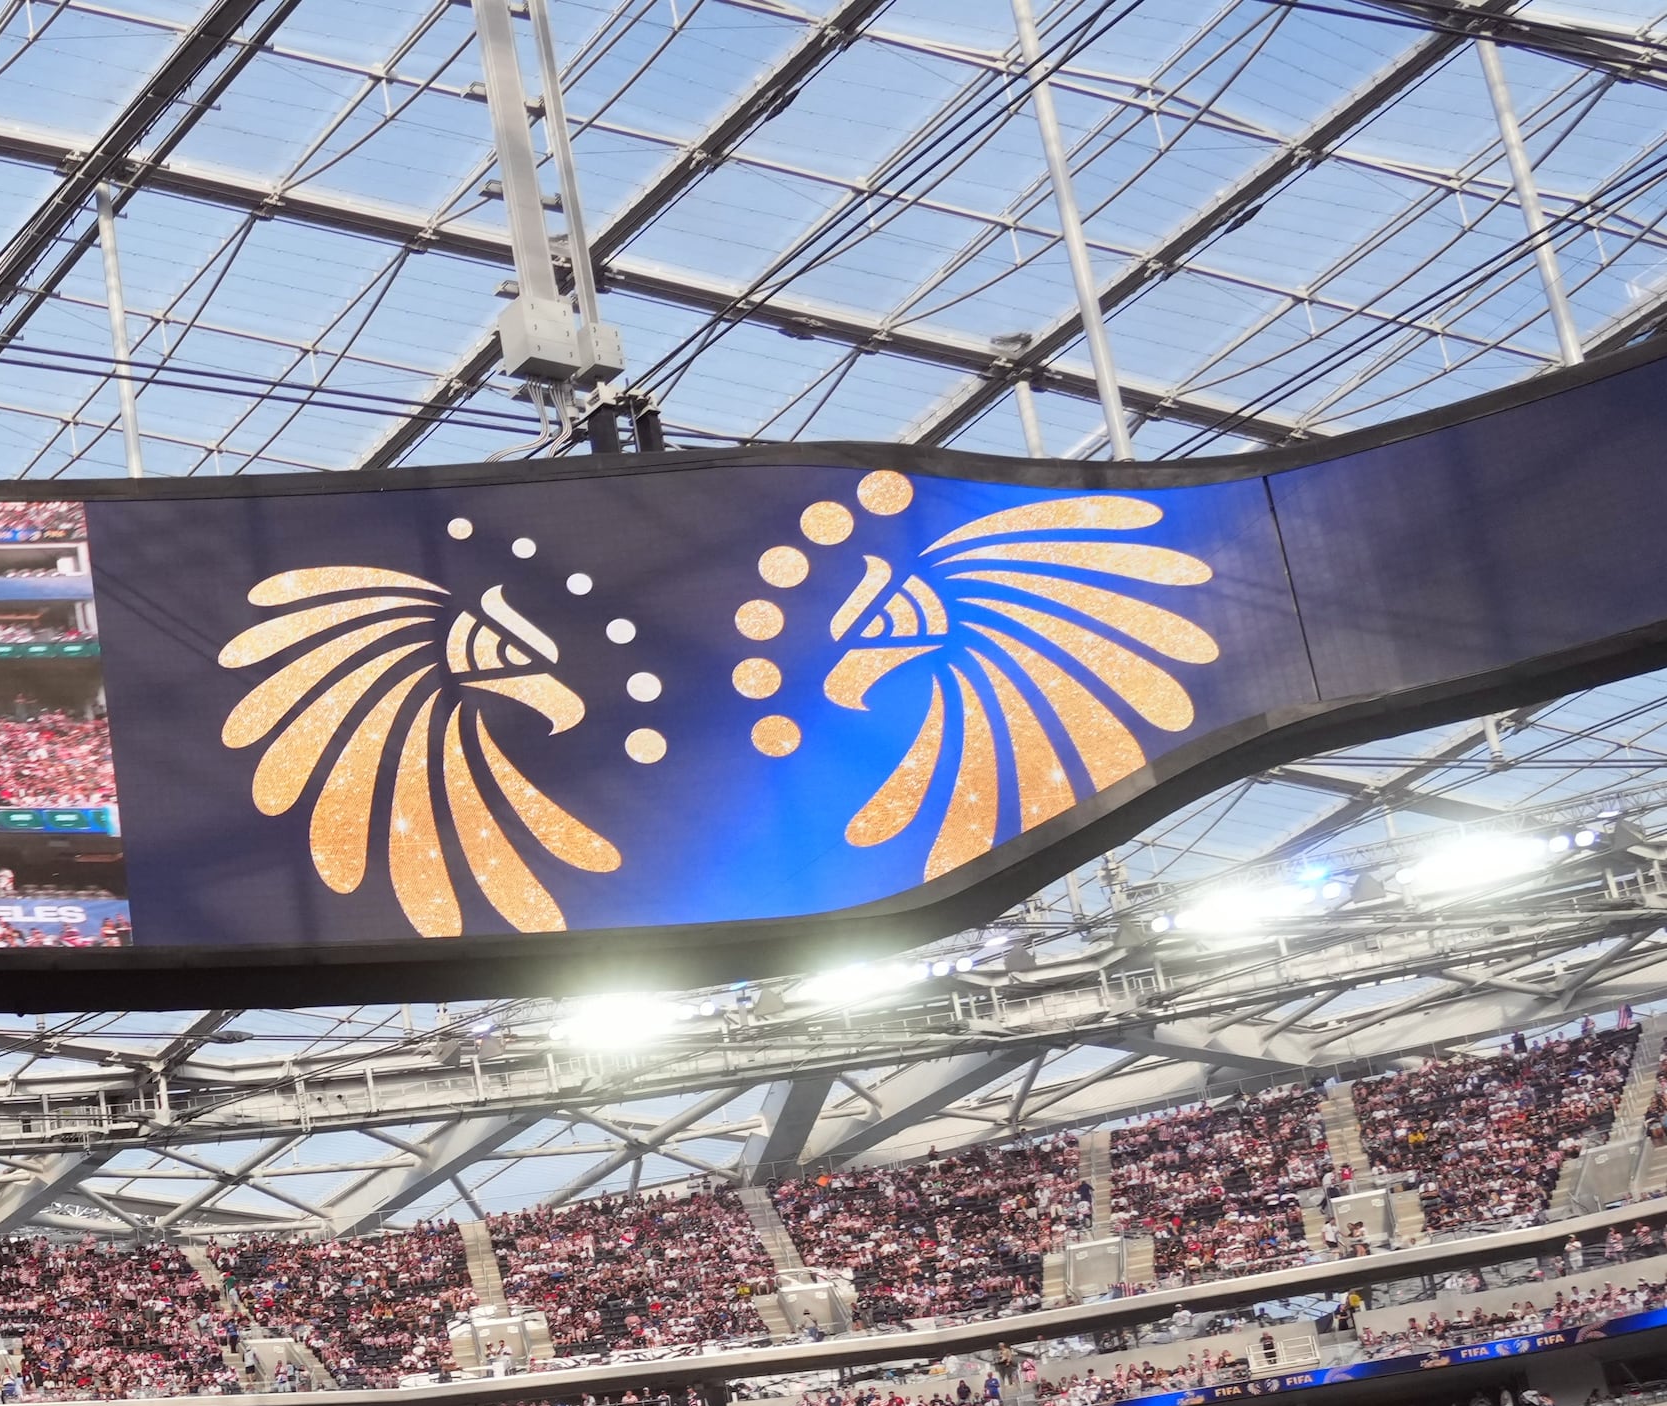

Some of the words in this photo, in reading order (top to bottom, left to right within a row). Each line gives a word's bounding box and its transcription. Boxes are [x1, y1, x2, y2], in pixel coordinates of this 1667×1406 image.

[1536, 1334, 1565, 1346] FIFA
[1461, 1347, 1489, 1358] FIFA
[1286, 1375, 1313, 1385] FIFA
[1215, 1386, 1242, 1397] FIFA
